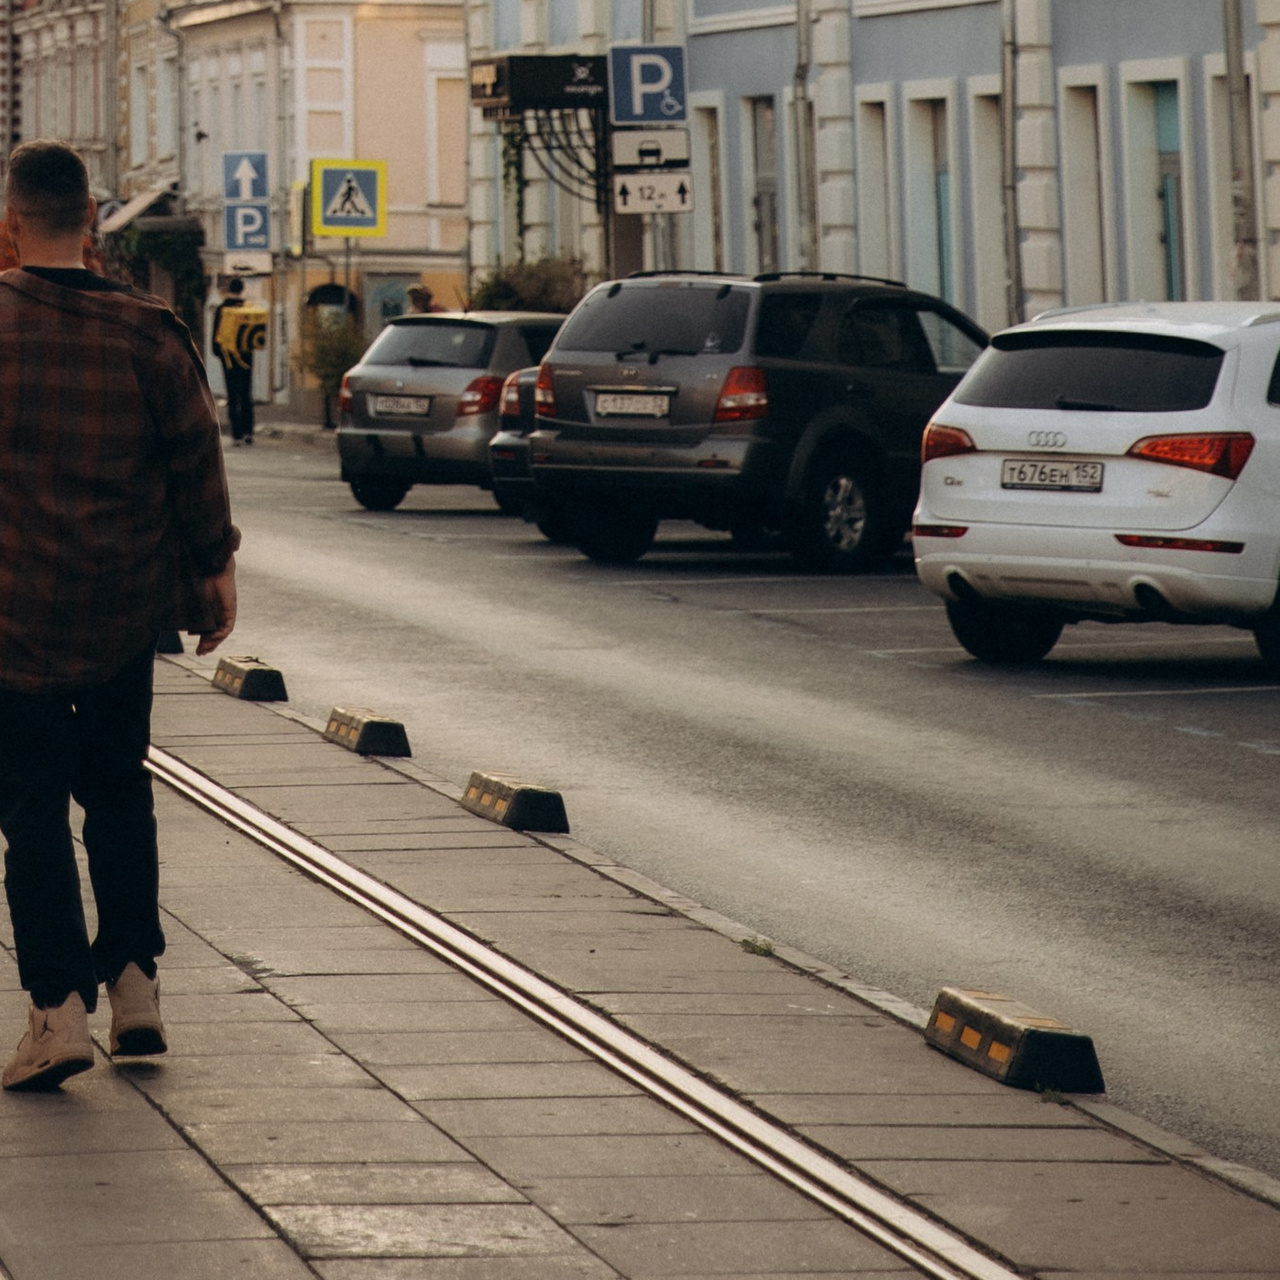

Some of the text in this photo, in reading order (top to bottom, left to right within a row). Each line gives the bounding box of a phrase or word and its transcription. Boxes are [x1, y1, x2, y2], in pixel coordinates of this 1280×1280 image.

[630, 53, 673, 116] P
[638, 184, 657, 201] 12
[235, 207, 263, 246] P
[1074, 463, 1098, 481] 152
